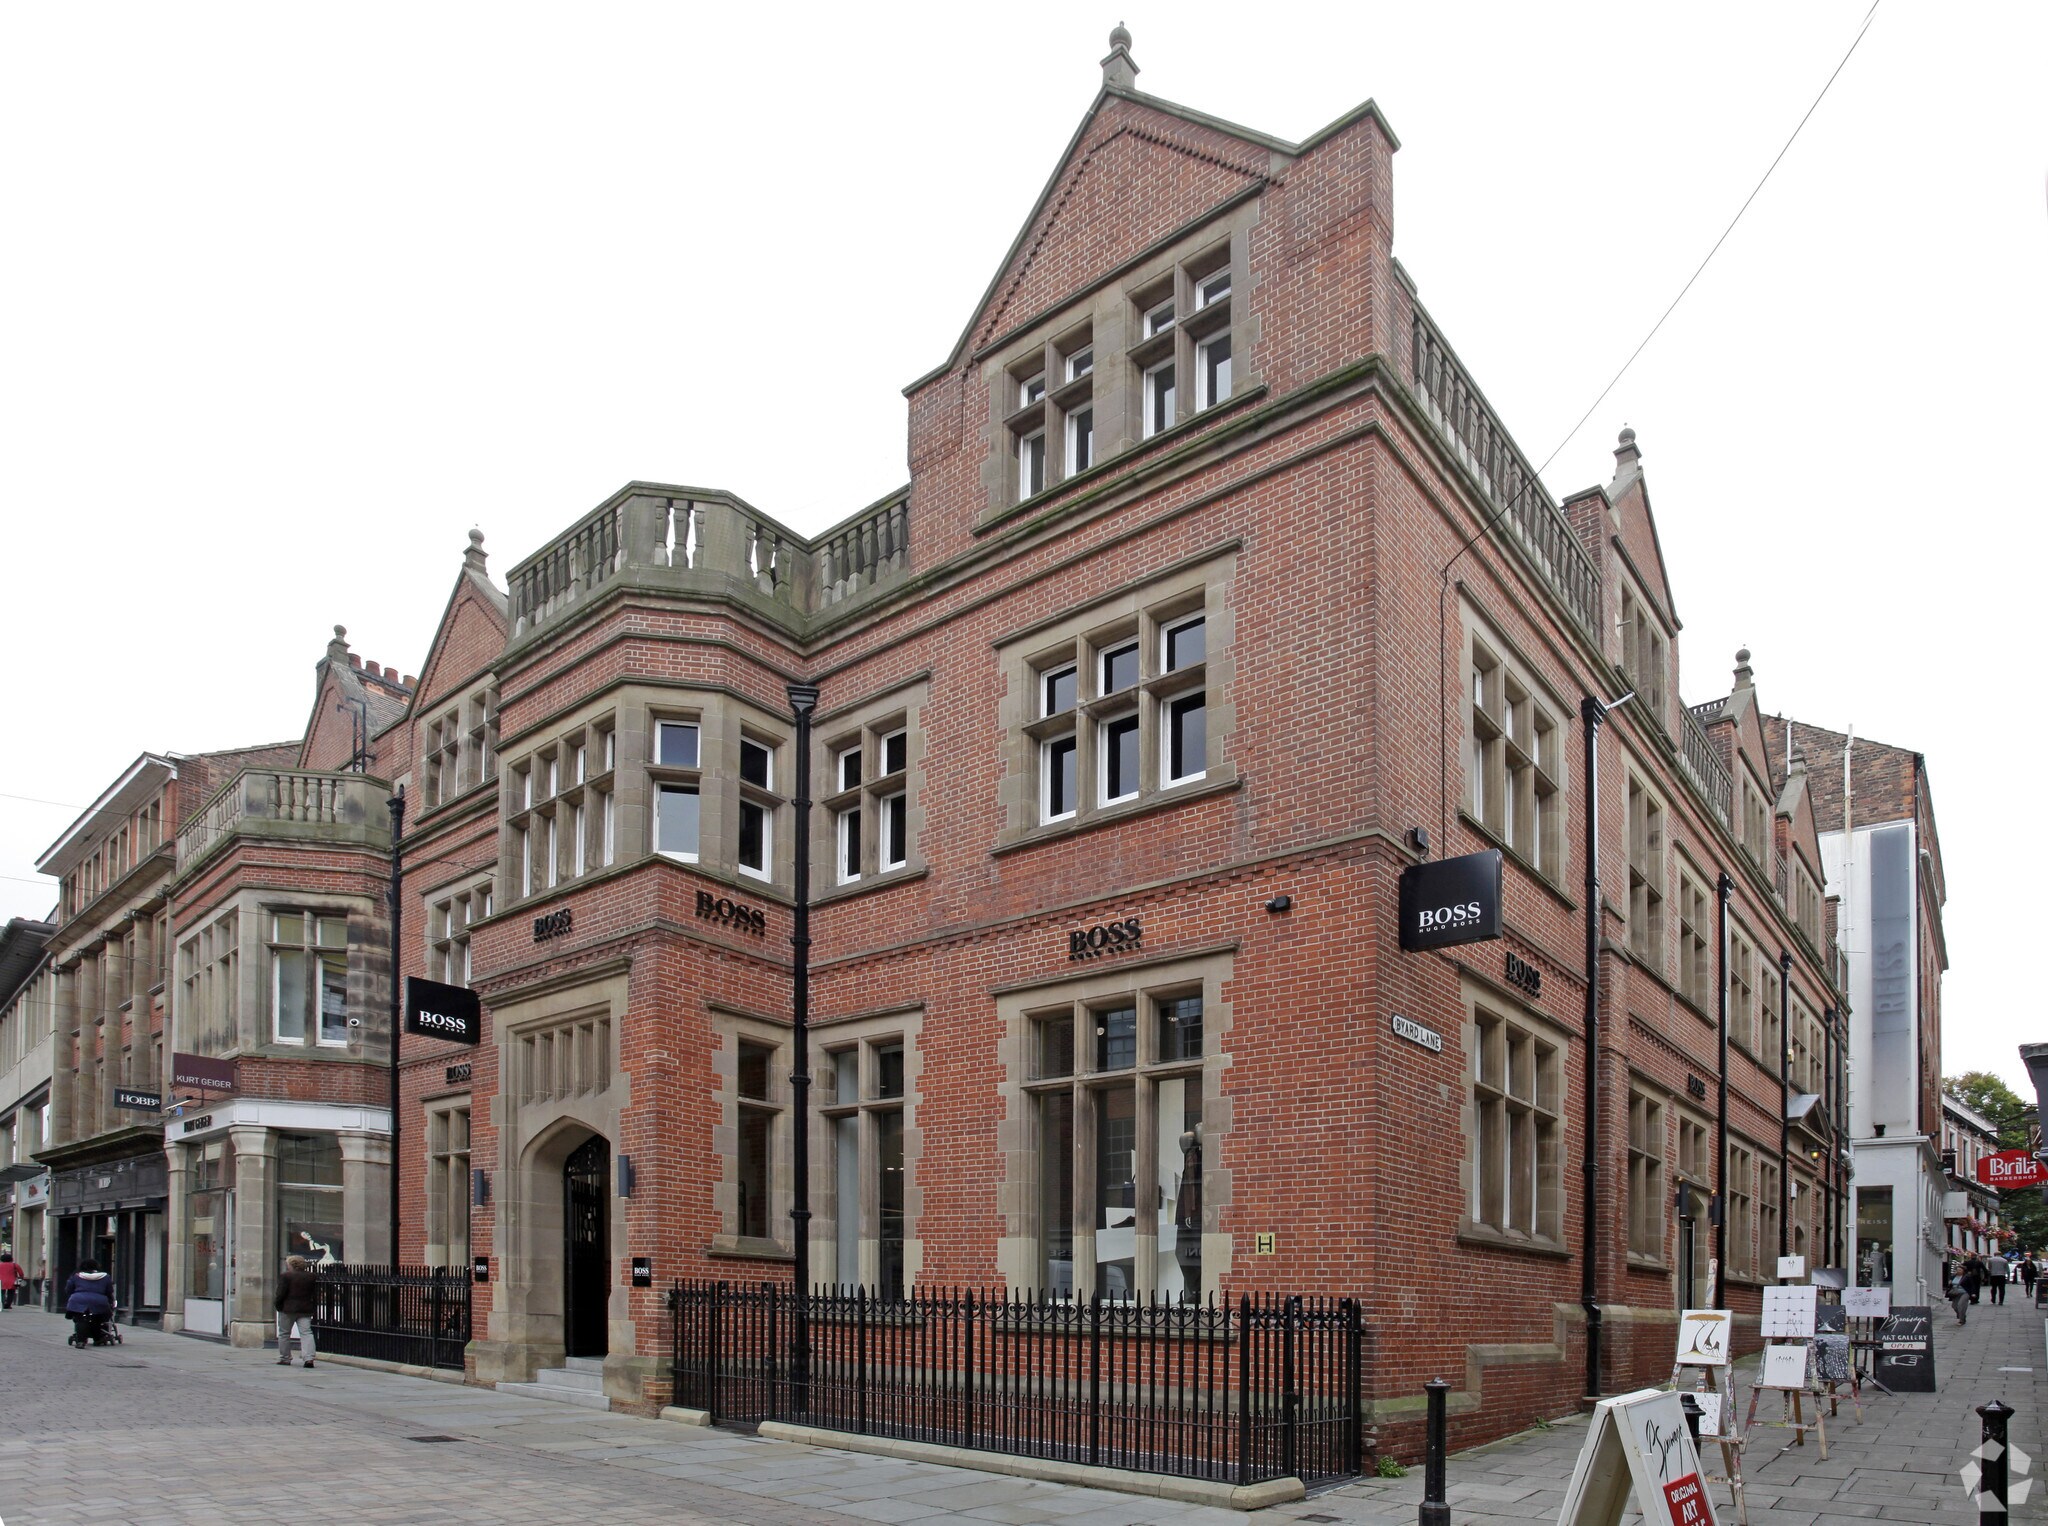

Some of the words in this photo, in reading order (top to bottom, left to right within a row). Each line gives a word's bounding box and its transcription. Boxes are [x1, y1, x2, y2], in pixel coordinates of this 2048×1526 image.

[533, 908, 572, 936] BOSS
[696, 890, 766, 928] BOSS
[1419, 901, 1481, 927] BOSS
[1069, 918, 1141, 953] BOSS
[1419, 924, 1446, 933] HUGO
[1452, 919, 1480, 928] BOSS
[1506, 951, 1541, 990] BOSS
[420, 1010, 466, 1030] BOSS
[1395, 1018, 1419, 1039] BYARD
[1420, 1029, 1440, 1050] LANE
[176, 1075, 199, 1085] KURT
[201, 1078, 232, 1089] GEIGER
[1990, 1157, 2037, 1176] Brik
[1682, 1499, 1699, 1524] ART
